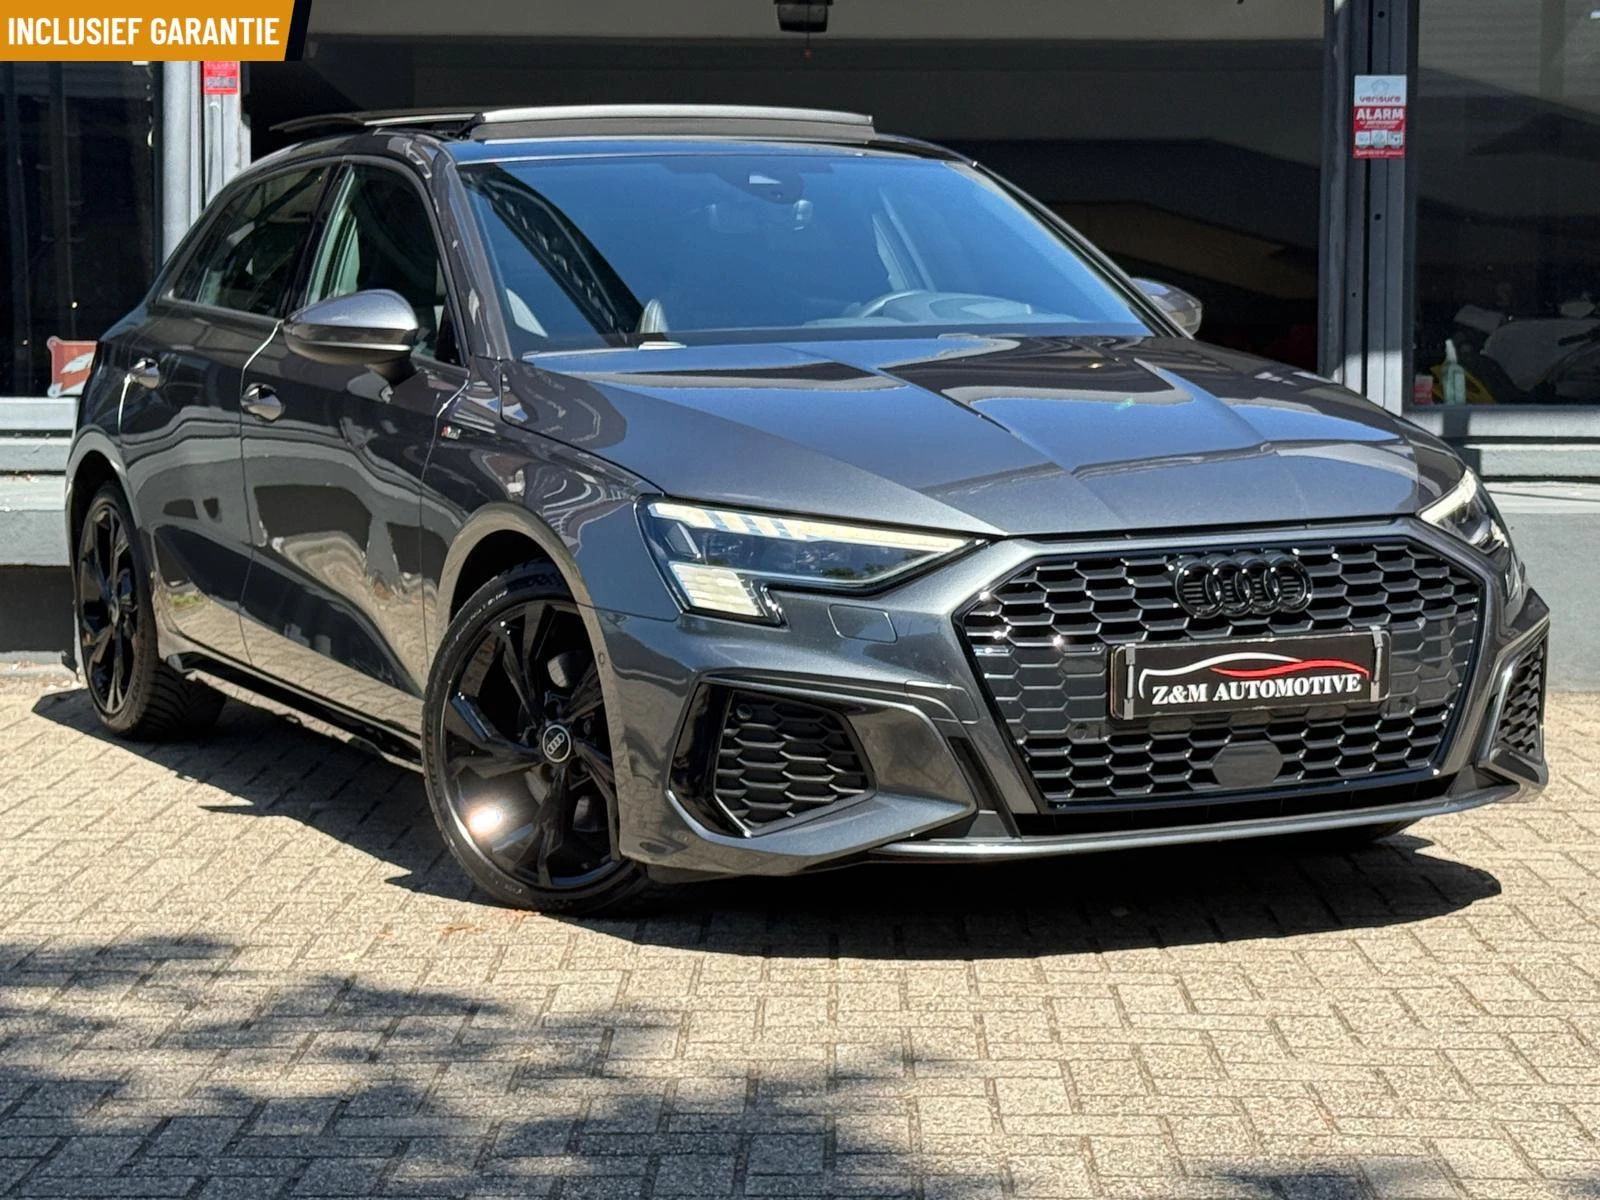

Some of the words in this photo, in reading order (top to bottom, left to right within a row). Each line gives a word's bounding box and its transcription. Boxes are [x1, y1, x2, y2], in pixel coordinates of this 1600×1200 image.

[1359, 95, 1402, 103] verisure
[1356, 108, 1404, 120] ALARM
[1151, 683, 1208, 705] Z&M
[1213, 673, 1362, 701] AUTOMOTIVE
